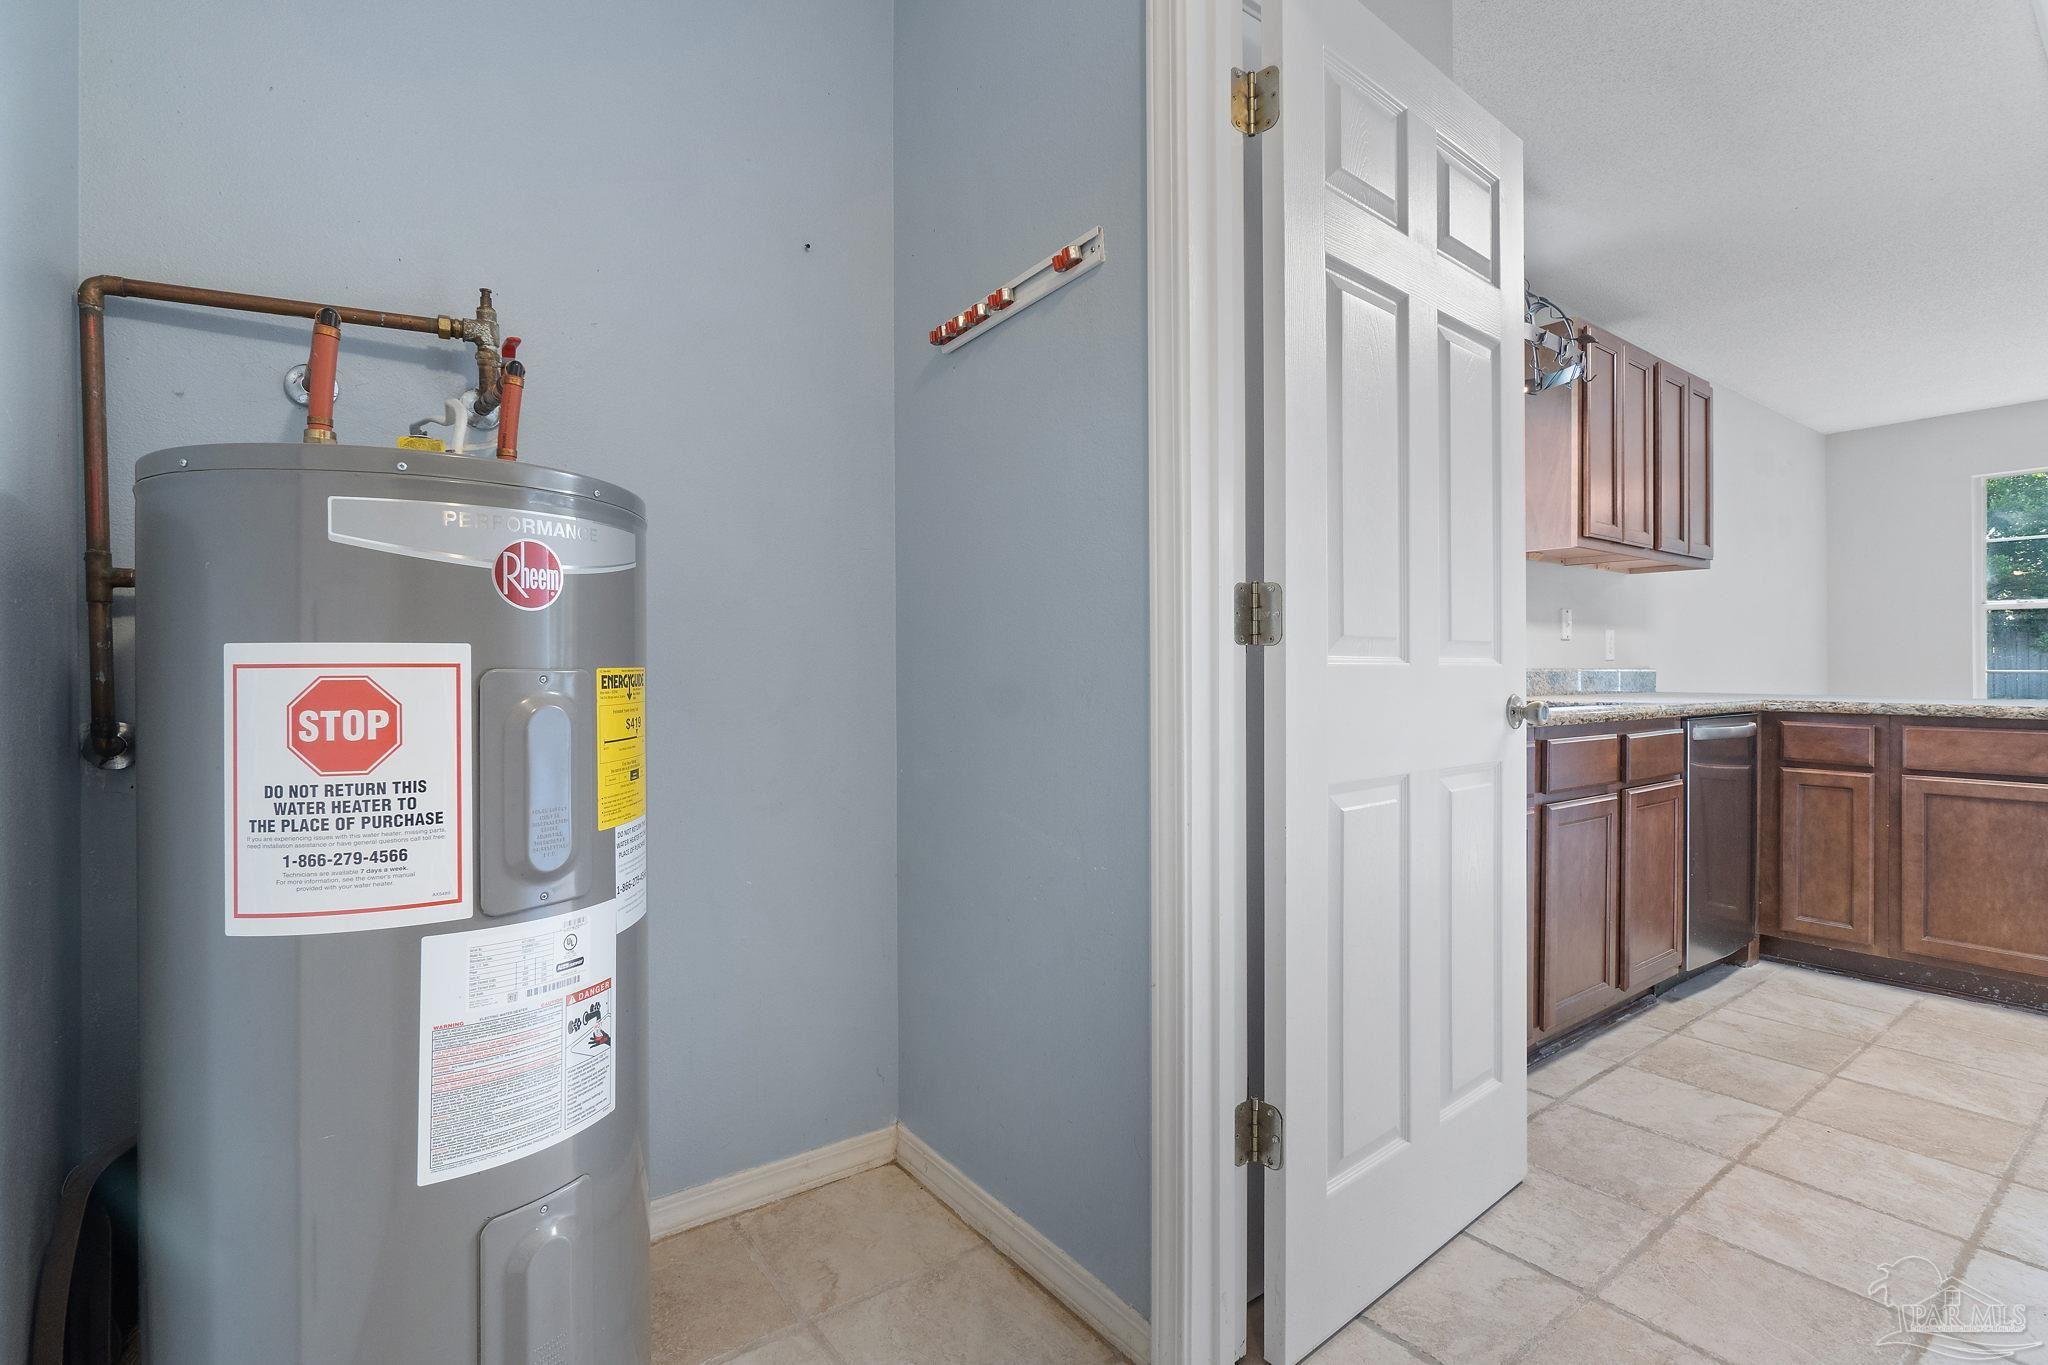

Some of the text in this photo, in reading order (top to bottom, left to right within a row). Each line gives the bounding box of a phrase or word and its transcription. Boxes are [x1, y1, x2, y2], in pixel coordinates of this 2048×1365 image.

[443, 510, 598, 542] PERFORMANCE
[502, 541, 559, 598] Rheem
[298, 709, 390, 742] STOP
[264, 780, 427, 798] DO NOT RETURN THIS
[274, 797, 416, 815] WATER HEATER TO
[249, 811, 443, 833] THE PLACE OF PURCHASE
[404, 828, 428, 836] missing
[353, 838, 378, 847] general
[379, 836, 409, 844] questions
[283, 849, 408, 868] 1-866-279-4566
[338, 883, 352, 891] your
[578, 981, 610, 1001] DANGER
[433, 1021, 465, 1031] WARNING
